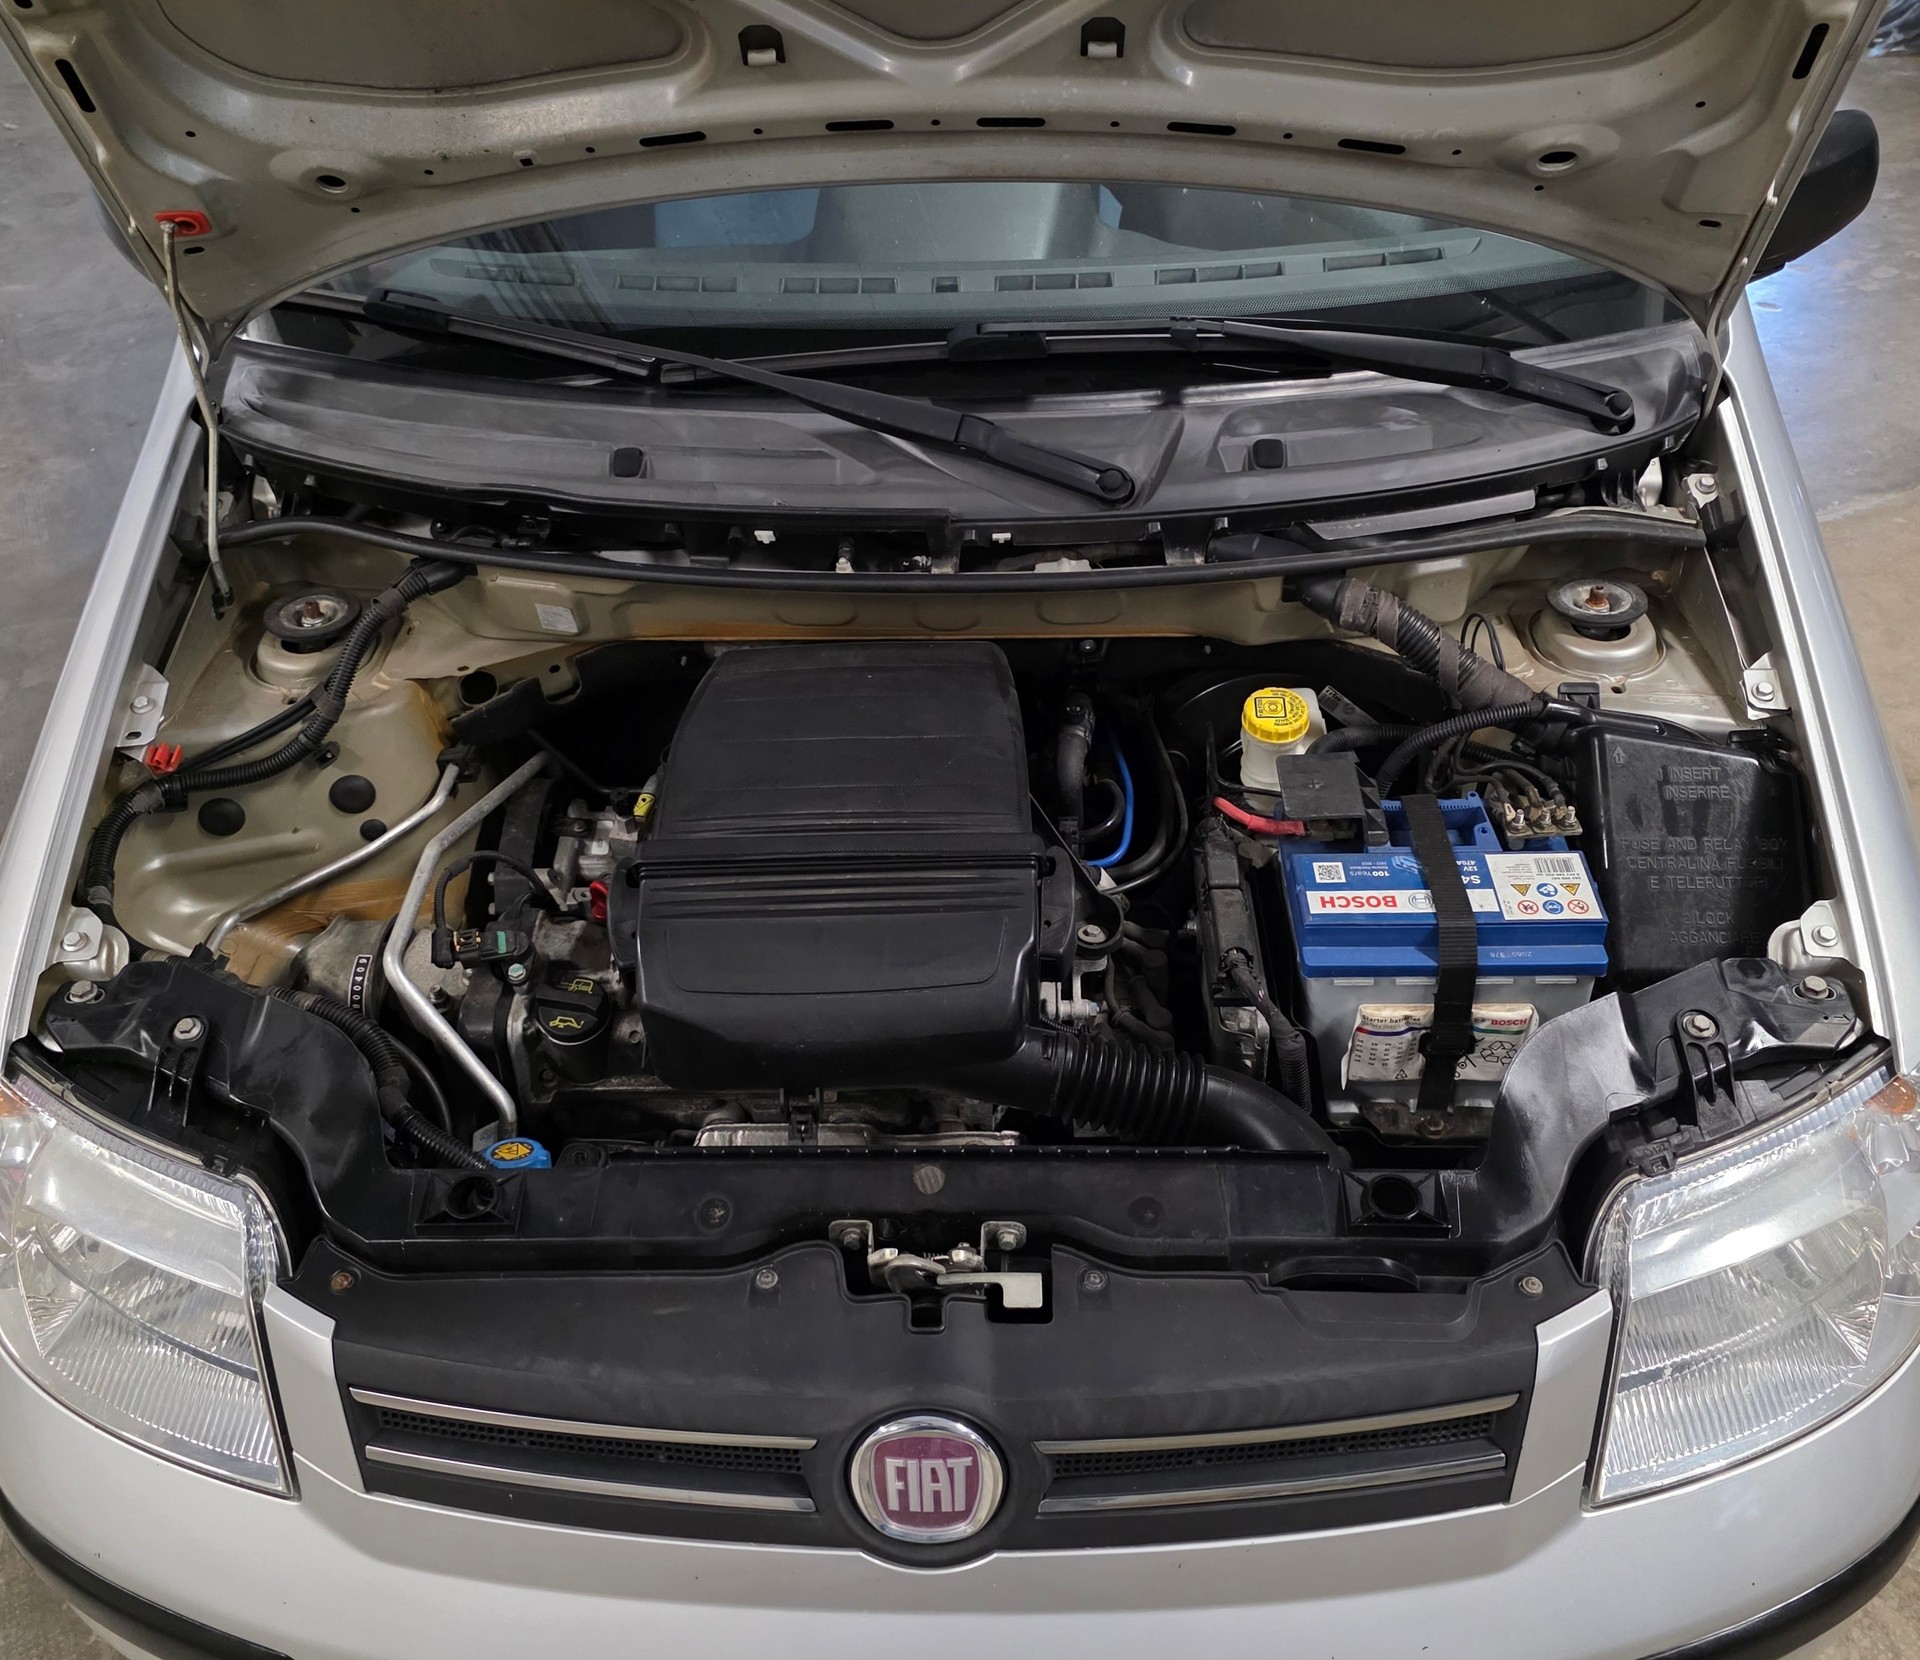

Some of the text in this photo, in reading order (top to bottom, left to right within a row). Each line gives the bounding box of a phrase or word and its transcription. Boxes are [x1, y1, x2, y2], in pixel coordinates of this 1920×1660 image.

[1668, 767, 1721, 782] INSERT
[1664, 785, 1731, 800] INSERIRE
[1621, 838, 1661, 851] FUSE
[1666, 837, 1697, 851] AND
[1704, 837, 1750, 851] RELAY
[1626, 857, 1720, 870] CENTRALINA
[1461, 875, 1481, 885] S4
[1650, 876, 1661, 889] E
[1319, 895, 1398, 909] BOSCH
[1695, 911, 1736, 926] LOCK
[1361, 1014, 1388, 1024] Starter
[1490, 1018, 1528, 1026] BOSCH
[884, 1456, 973, 1513] FIAT
